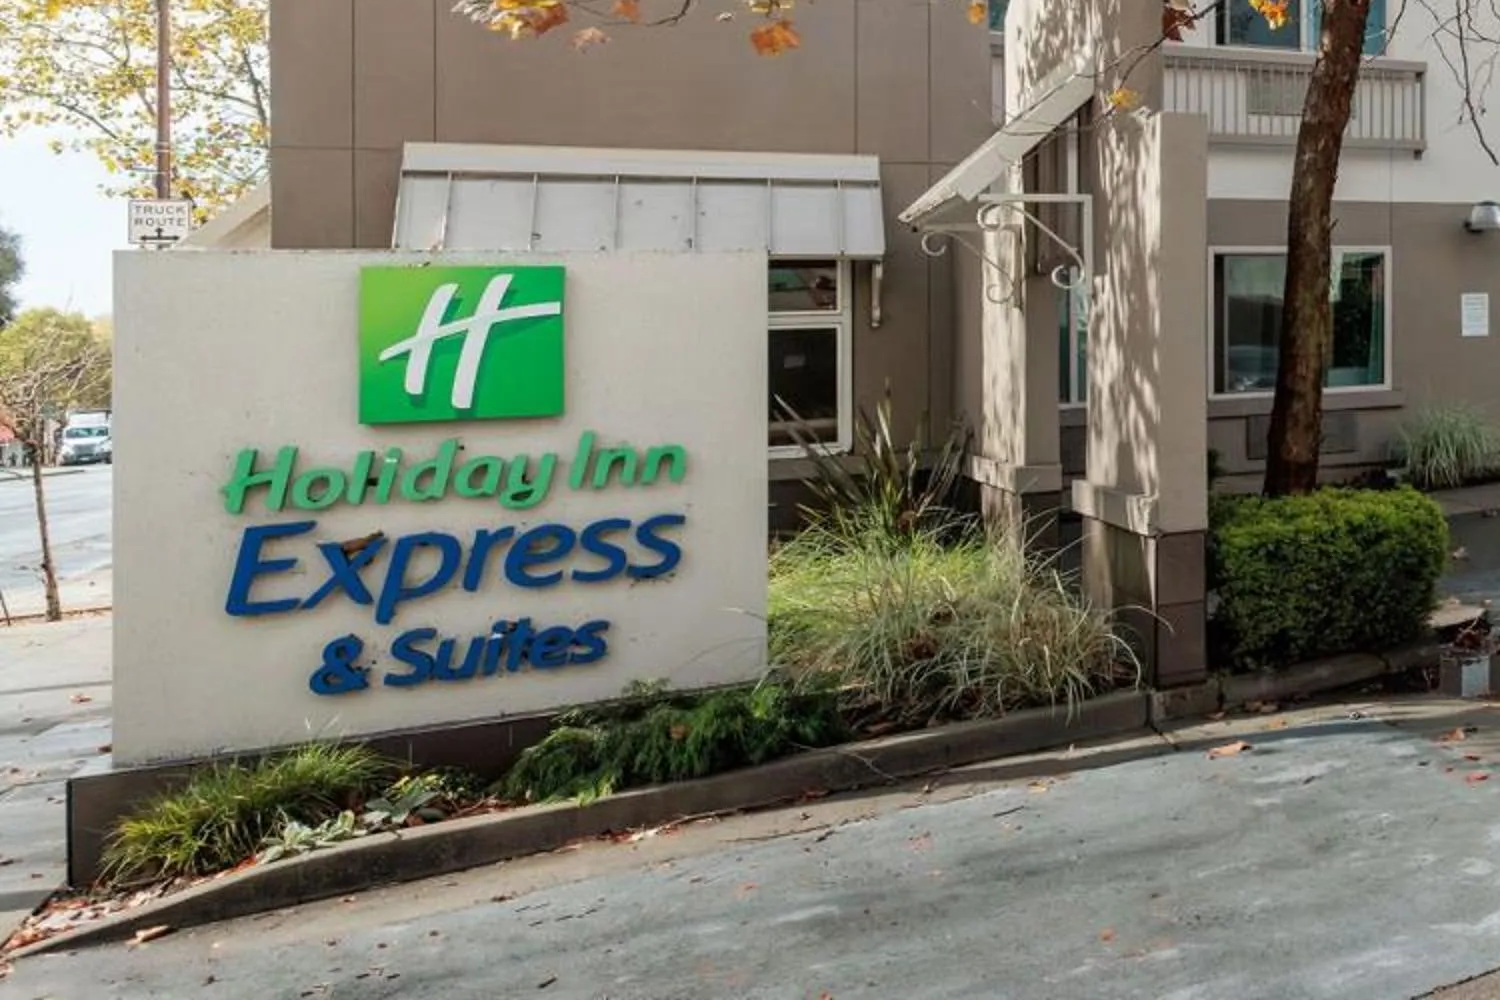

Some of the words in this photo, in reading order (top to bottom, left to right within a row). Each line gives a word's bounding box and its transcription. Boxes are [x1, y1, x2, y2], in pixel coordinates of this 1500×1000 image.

[134, 217, 185, 226] ROUTE
[135, 205, 185, 214] TRUCK
[222, 438, 557, 514] Holiday
[569, 430, 687, 490] Inn
[225, 514, 686, 625] Express
[309, 634, 369, 696] &
[384, 618, 610, 688] Suites
